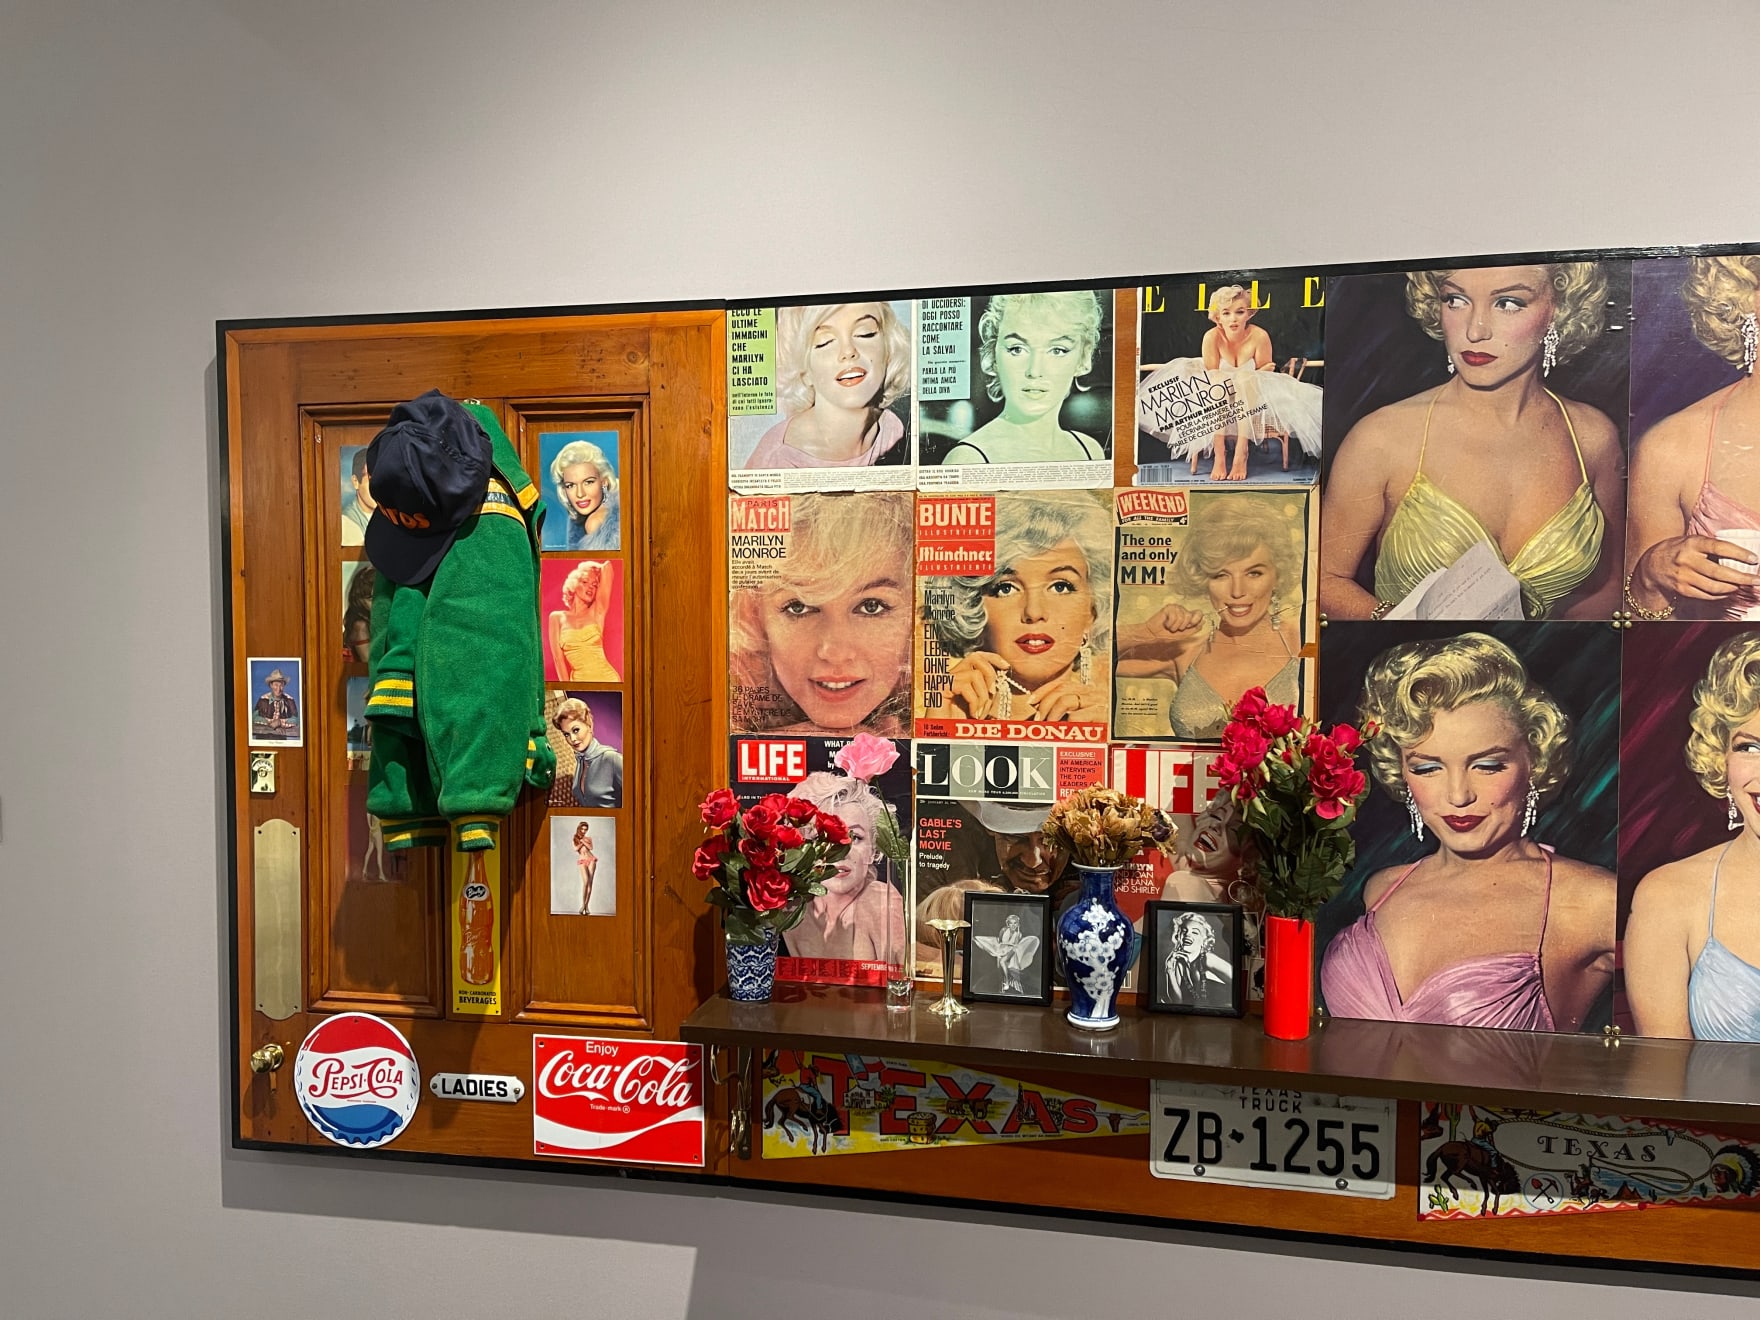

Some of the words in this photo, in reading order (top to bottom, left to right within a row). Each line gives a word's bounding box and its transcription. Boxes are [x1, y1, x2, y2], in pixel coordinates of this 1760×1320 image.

[1142, 276, 1325, 313] ELLE
[931, 298, 966, 309] UCCIDERSI:
[922, 311, 937, 321] OGGI
[940, 310, 960, 320] POSSO
[732, 319, 758, 329] ULTIME
[922, 321, 963, 332] RACCONTARE
[732, 330, 768, 340] IMMAGINI
[922, 334, 940, 344] COME
[732, 342, 747, 352] CHE
[922, 346, 930, 355] LA
[933, 345, 956, 355] SALVAI
[732, 354, 764, 363] MARILYN
[732, 366, 740, 375] CI
[742, 365, 752, 375] HA
[732, 377, 768, 387] LASCIATO
[941, 376, 956, 384] AMICA
[1148, 376, 1180, 393] EXCLUSIF
[1140, 371, 1211, 415] MARILYN
[1155, 379, 1237, 427] MONROE
[1160, 423, 1174, 432] PAR
[1174, 411, 1203, 429] ARTHUR
[1203, 400, 1228, 414] MILLER
[1120, 492, 1186, 513] WEEKEND
[732, 500, 789, 529] MATCH
[920, 503, 992, 527] BUNTE
[731, 535, 784, 546] MARILYN
[1121, 534, 1145, 546] The
[1148, 537, 1172, 546] one
[731, 547, 787, 559] MONROE
[920, 546, 992, 562] Münchner
[1121, 548, 1146, 560] and
[1149, 548, 1178, 564] only
[924, 590, 955, 609] Marilyn
[924, 624, 939, 640] EIN
[924, 657, 950, 674] OHNE
[924, 675, 954, 691] HAPPY
[924, 692, 943, 708] END
[955, 723, 1001, 738] DIE
[1007, 724, 1103, 741] DONAU
[824, 740, 844, 748] WHAT
[741, 743, 804, 776] LIFE
[919, 754, 1051, 789] LOOK
[1113, 750, 1228, 813] LIFE
[919, 818, 962, 828] GABLE'S
[919, 829, 946, 839] LAST
[919, 841, 952, 850] MOVIE
[919, 852, 943, 860] Prelude
[927, 862, 950, 870] tragedy
[1130, 878, 1154, 886] LANA
[1131, 885, 1160, 894] SHIRLEY
[459, 996, 497, 1005] BEVERAGES
[586, 1041, 619, 1057] Enjoy
[538, 1050, 701, 1108] Coca-Cola
[441, 1078, 508, 1099] LADIES
[814, 1055, 1099, 1136] TEXAS
[1239, 1096, 1302, 1114] TRUCK
[1163, 1107, 1222, 1165] ZB
[1250, 1116, 1380, 1180] 1255
[1536, 1134, 1656, 1163] TEXAS
